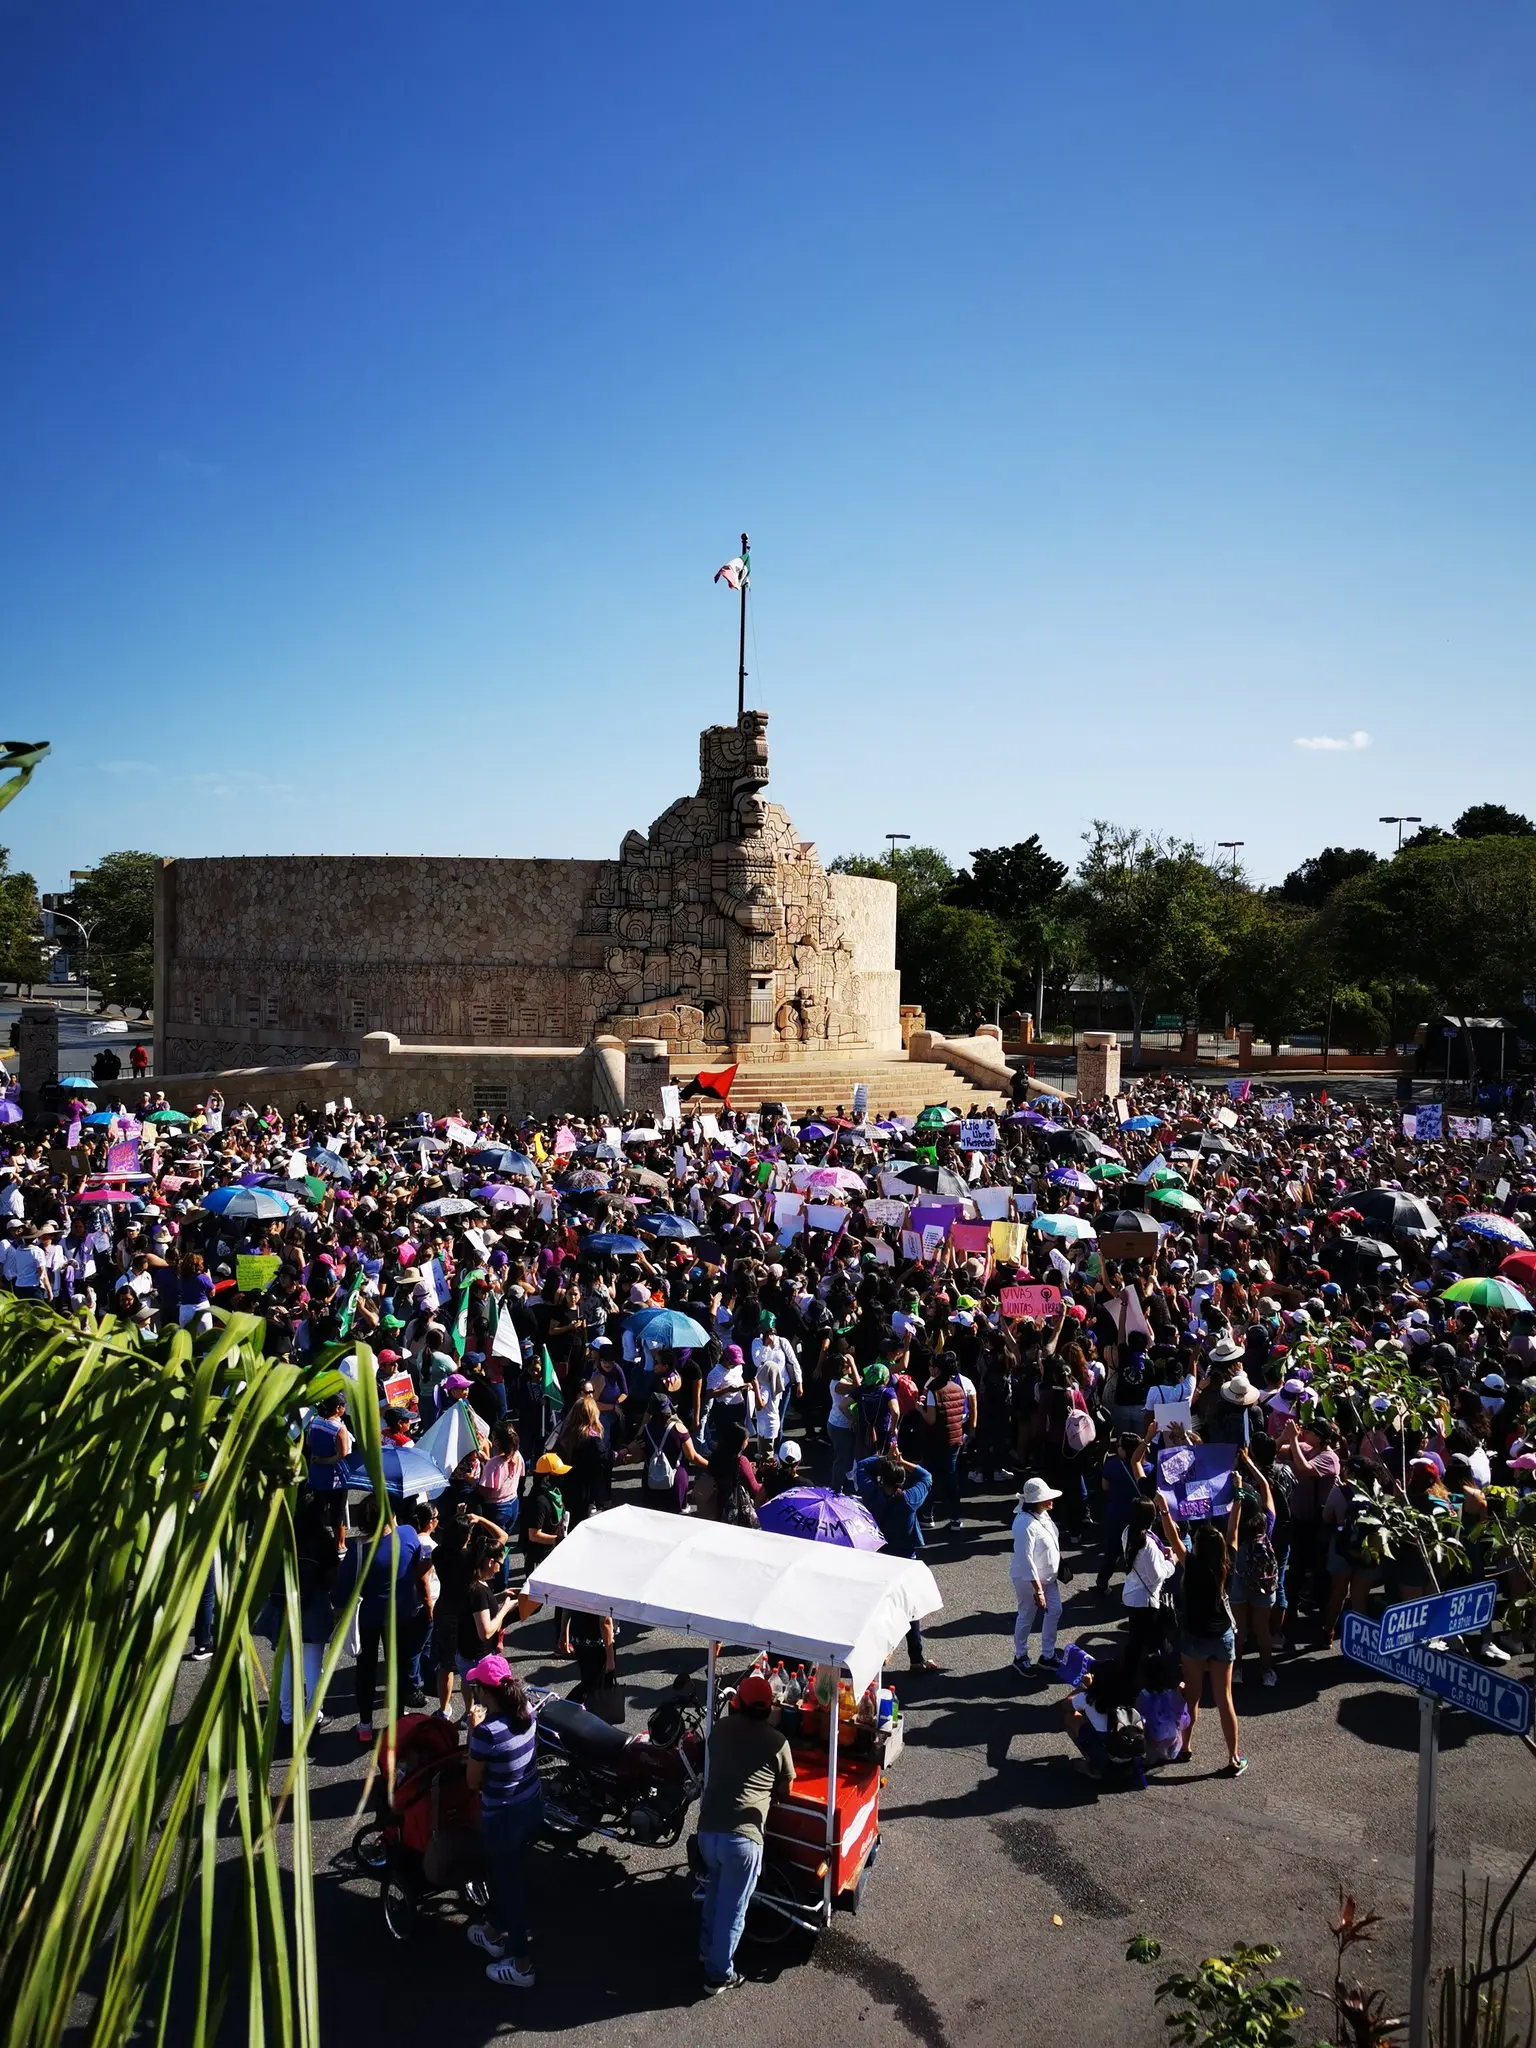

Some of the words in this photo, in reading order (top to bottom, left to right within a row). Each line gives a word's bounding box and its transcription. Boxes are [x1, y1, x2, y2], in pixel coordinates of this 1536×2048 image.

[972, 1130, 991, 1138] Libre
[1388, 1604, 1429, 1635] CALLE
[1395, 1662, 1416, 1681] CALLE
[1408, 1647, 1491, 1698] MONTEJO
[1451, 1687, 1465, 1703] C.P.
[1465, 1693, 1489, 1713] 97100
